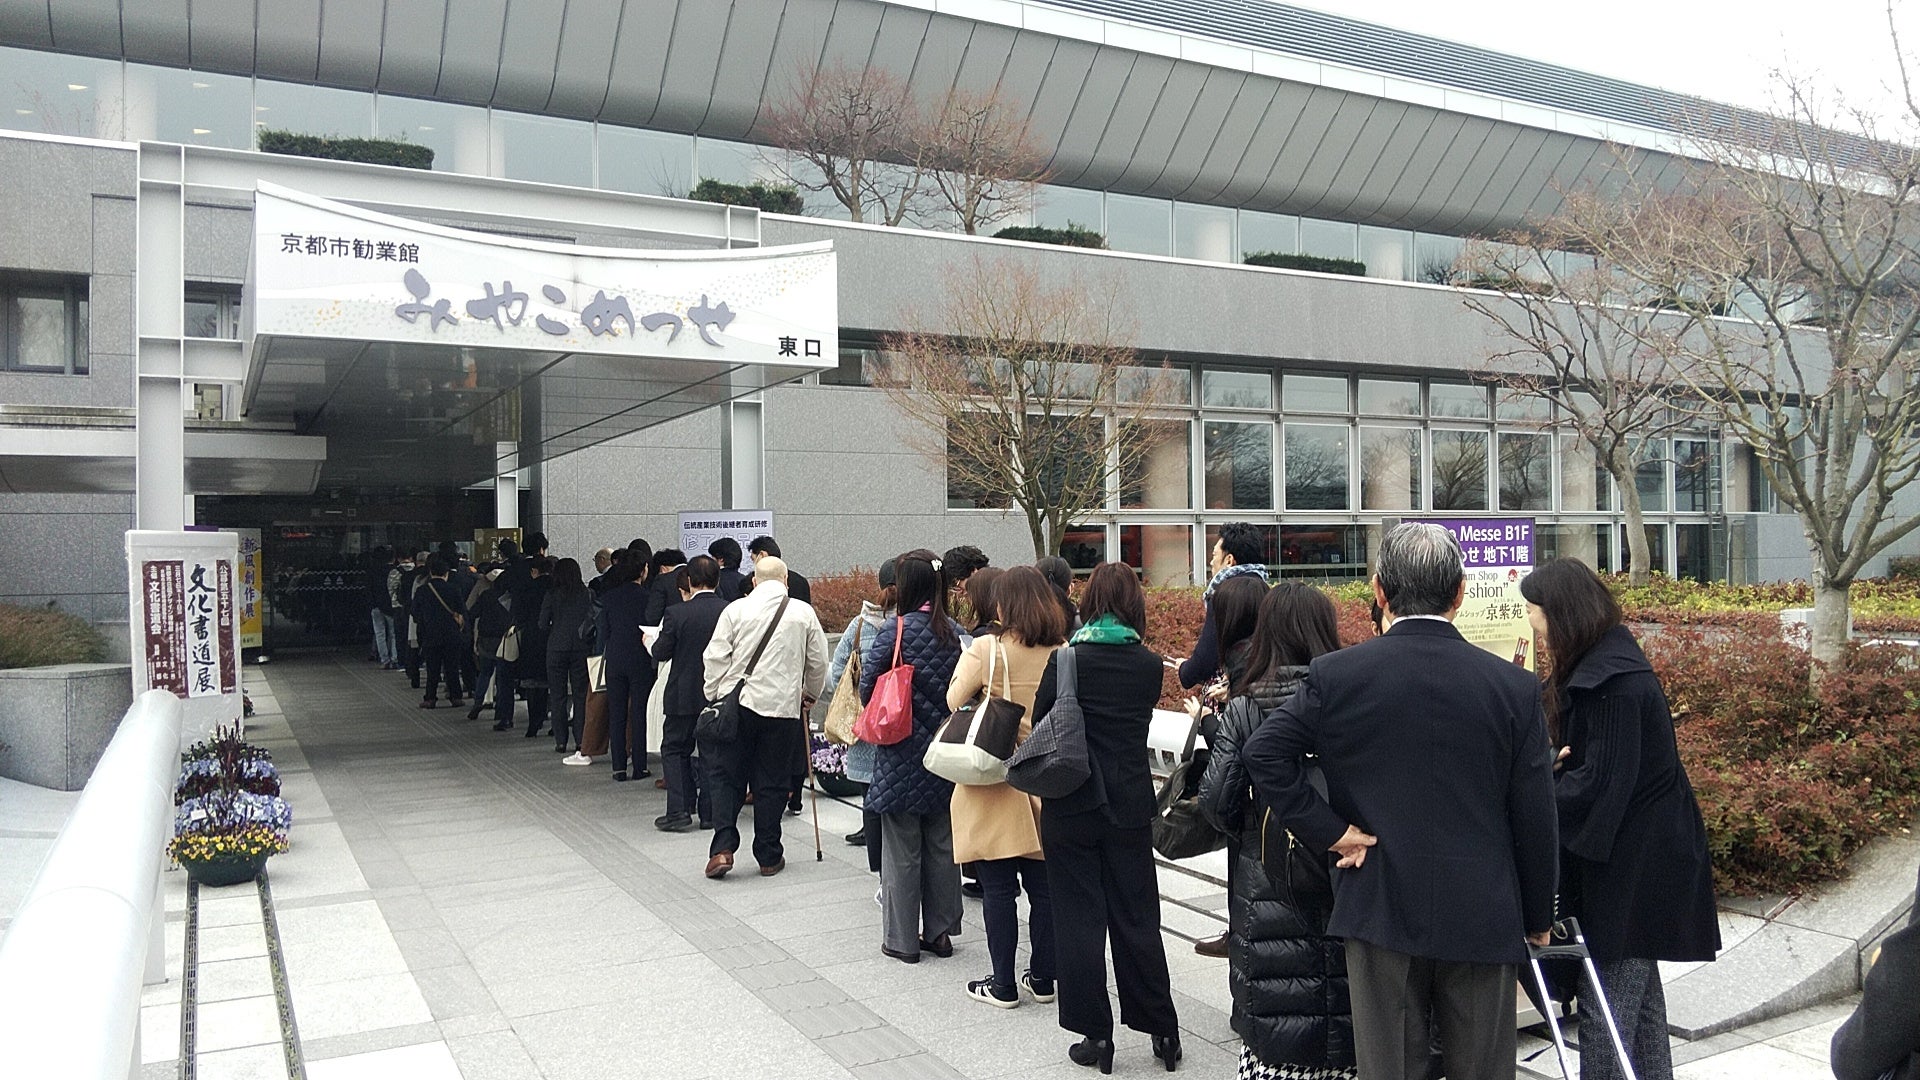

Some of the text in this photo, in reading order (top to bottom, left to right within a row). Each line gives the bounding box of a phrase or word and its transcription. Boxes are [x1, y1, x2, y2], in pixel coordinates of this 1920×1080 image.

[280, 232, 420, 263] 京都市勧業館
[395, 268, 737, 348] みやこめっせ
[778, 335, 822, 359] 東口
[682, 532, 770, 550] 修了品
[1460, 525, 1502, 542] Messe
[1505, 525, 1530, 541] B1F
[1483, 545, 1529, 564] 地下1階
[1478, 570, 1499, 582] Shop
[188, 564, 216, 694] 文化書道展
